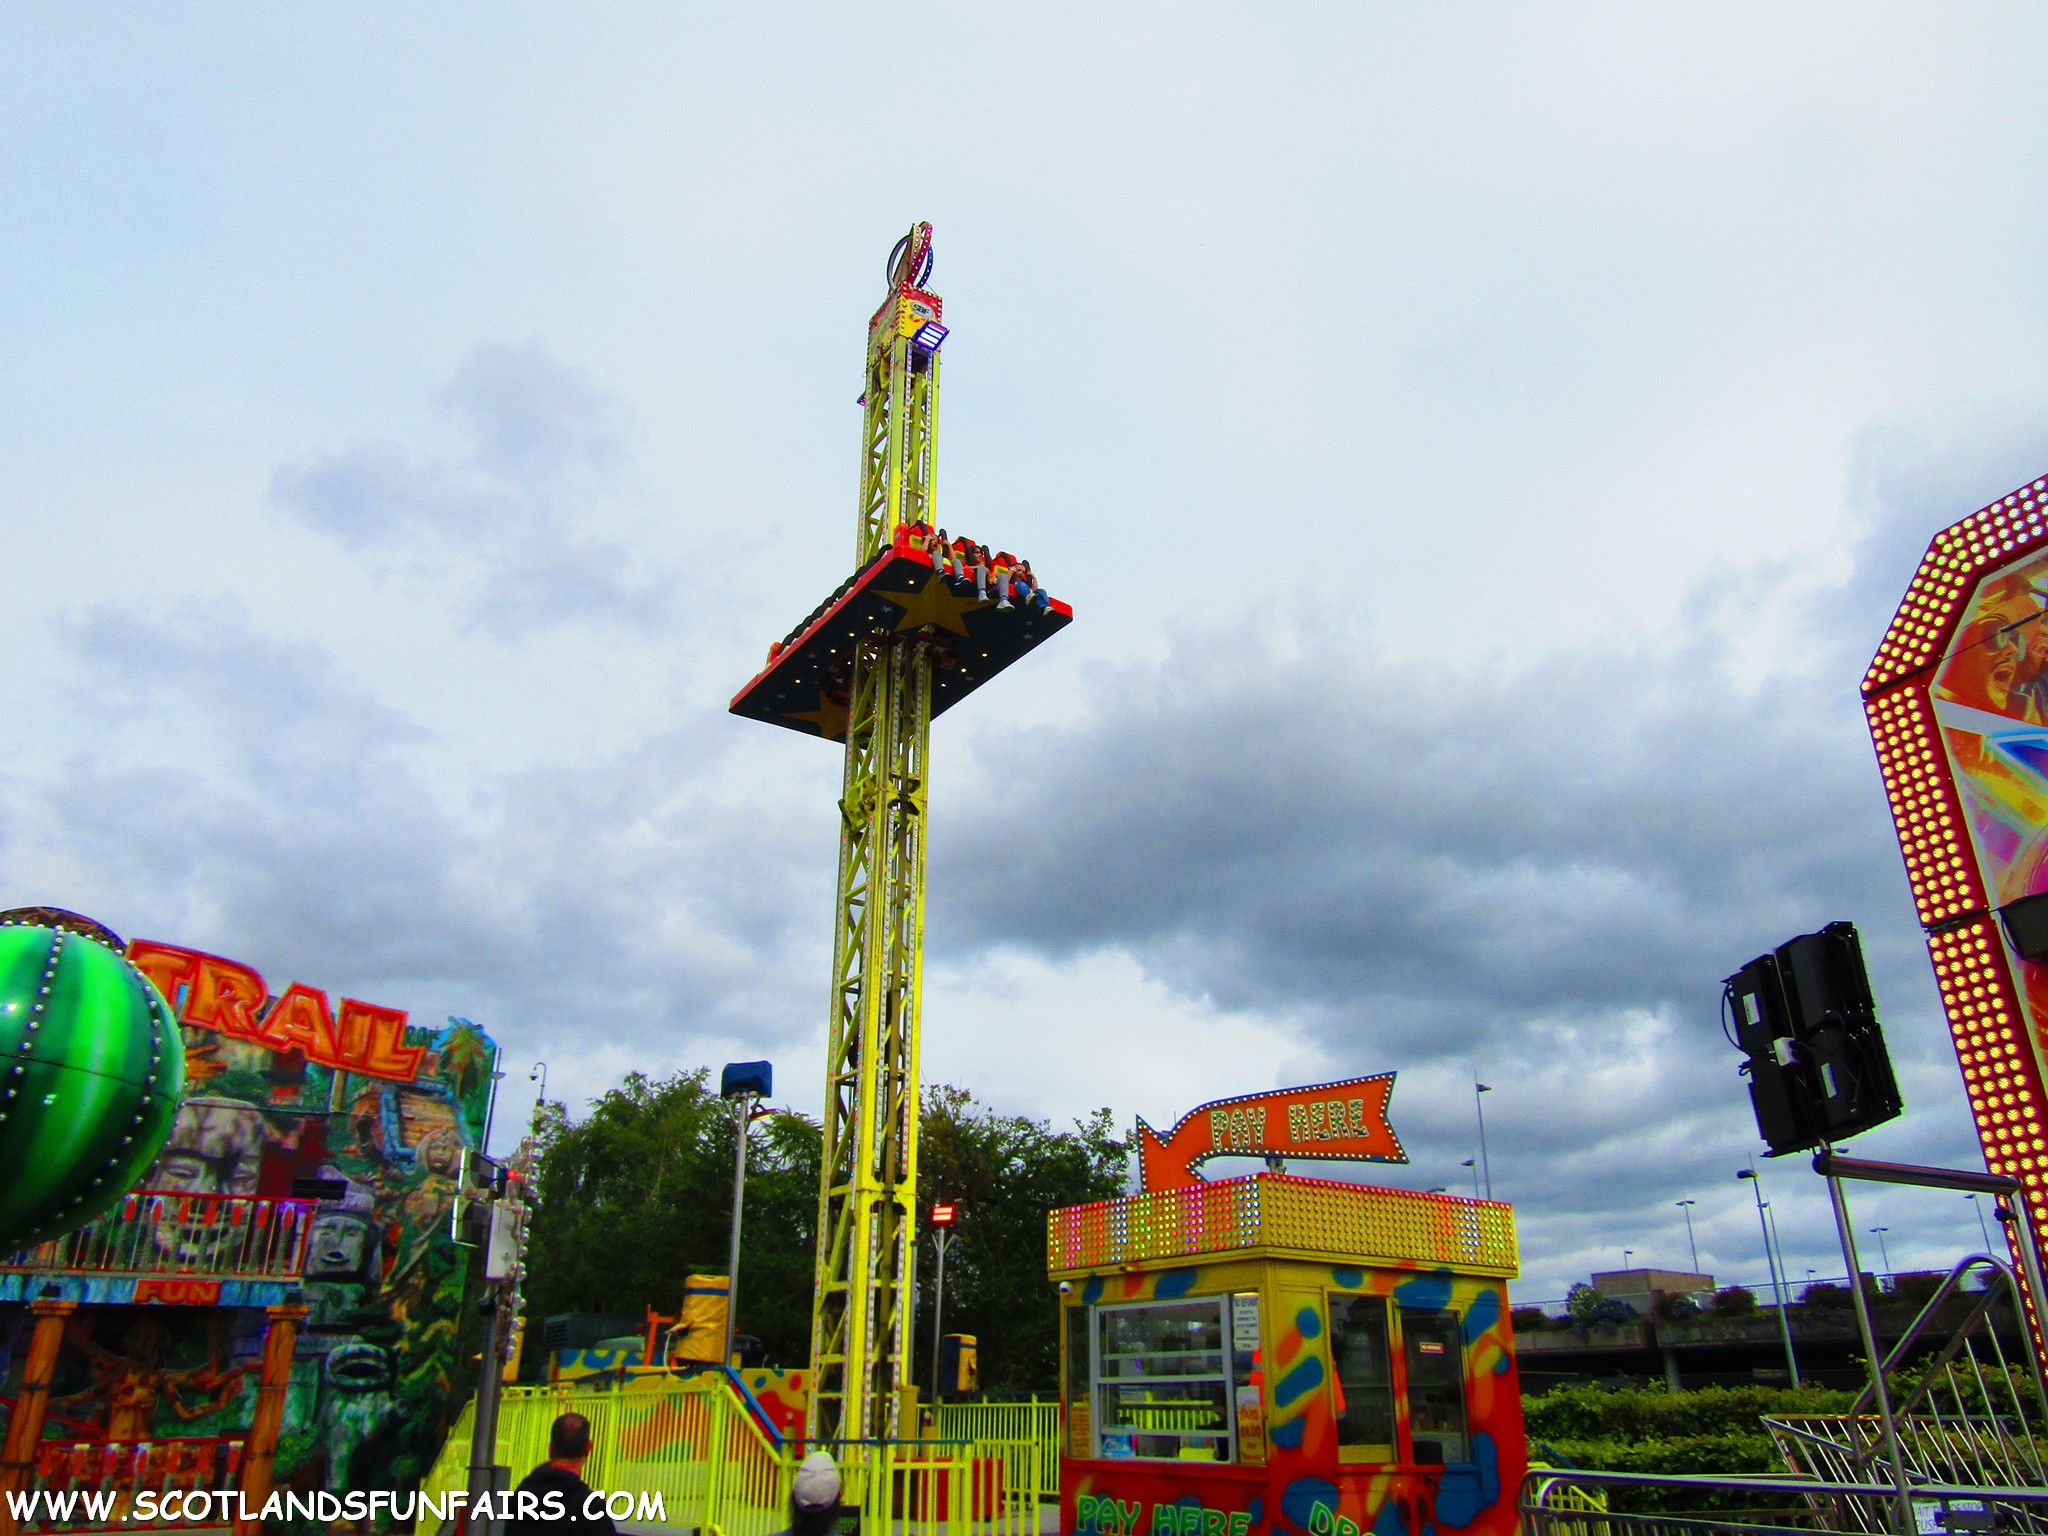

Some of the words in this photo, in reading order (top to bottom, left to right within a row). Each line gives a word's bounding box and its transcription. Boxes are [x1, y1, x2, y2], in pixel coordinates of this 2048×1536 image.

[125, 939, 426, 1082] TRAIL
[1211, 1107, 1266, 1150] PAY
[1289, 1098, 1370, 1142] HERE
[136, 1281, 219, 1304] FUN
[1077, 1495, 1142, 1536] PAY
[1152, 1503, 1252, 1536] HERE
